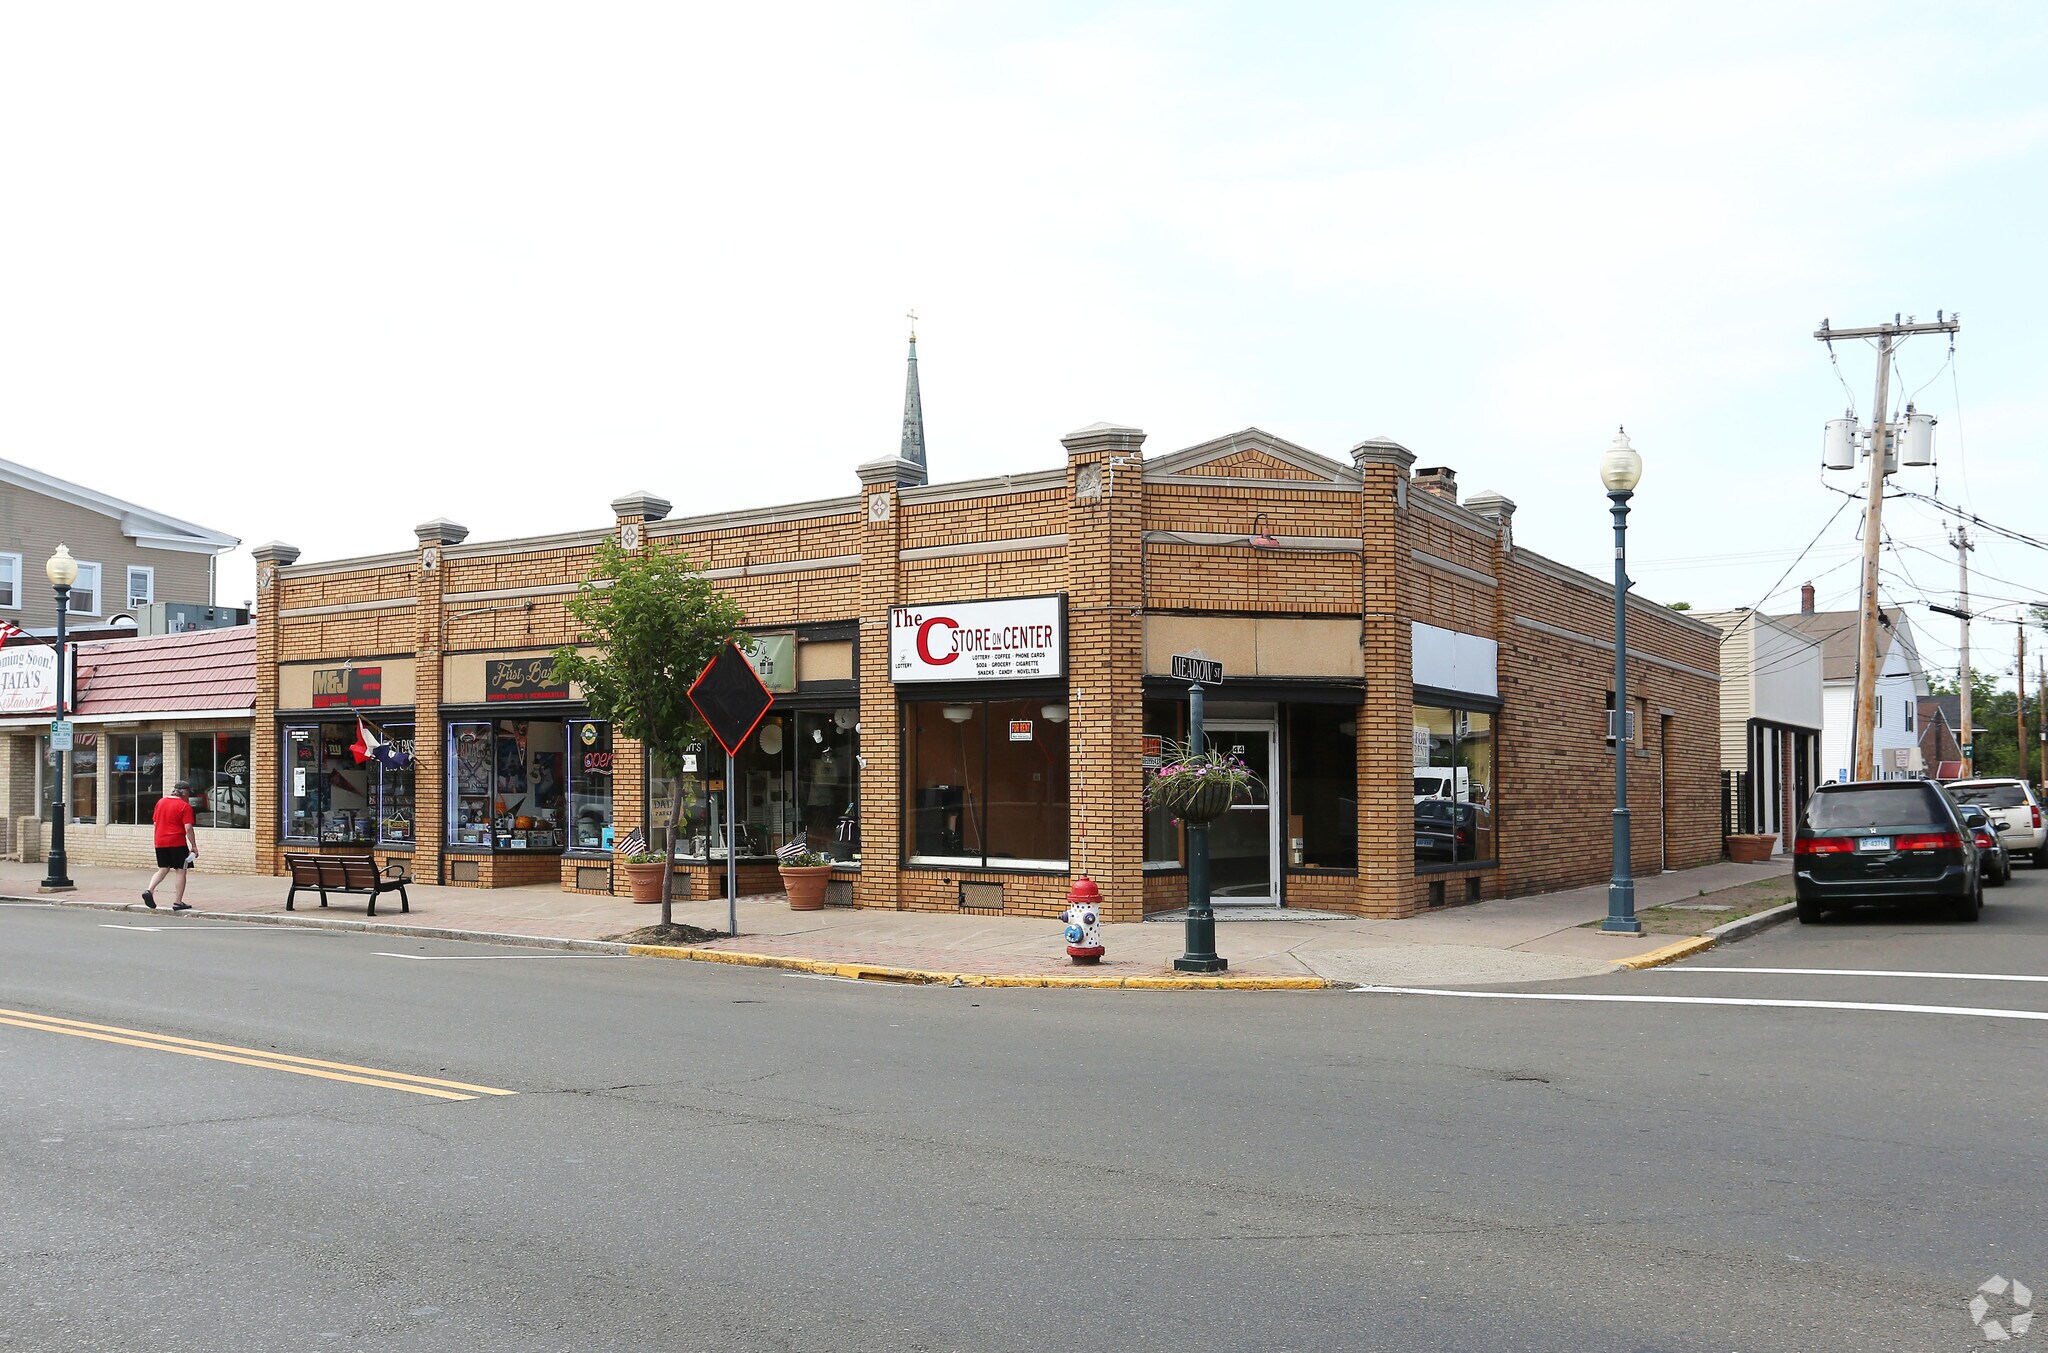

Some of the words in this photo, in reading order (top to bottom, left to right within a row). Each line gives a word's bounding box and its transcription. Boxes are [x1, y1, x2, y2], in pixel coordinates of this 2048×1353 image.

[894, 609, 922, 628] The
[916, 616, 960, 666] C
[951, 628, 991, 652] STORE
[992, 632, 1002, 646] ON
[1003, 625, 1053, 650] CENTER
[0, 650, 24, 668] ming
[26, 649, 54, 670] Soon!
[1173, 656, 1214, 681] MEADOW
[1213, 667, 1221, 678] ST
[2, 669, 41, 690] TATA'S
[313, 670, 349, 694] M&J
[492, 661, 524, 687] First
[526, 660, 561, 683] Bas
[53, 723, 58, 731] 2
[1020, 722, 1030, 733] RENT
